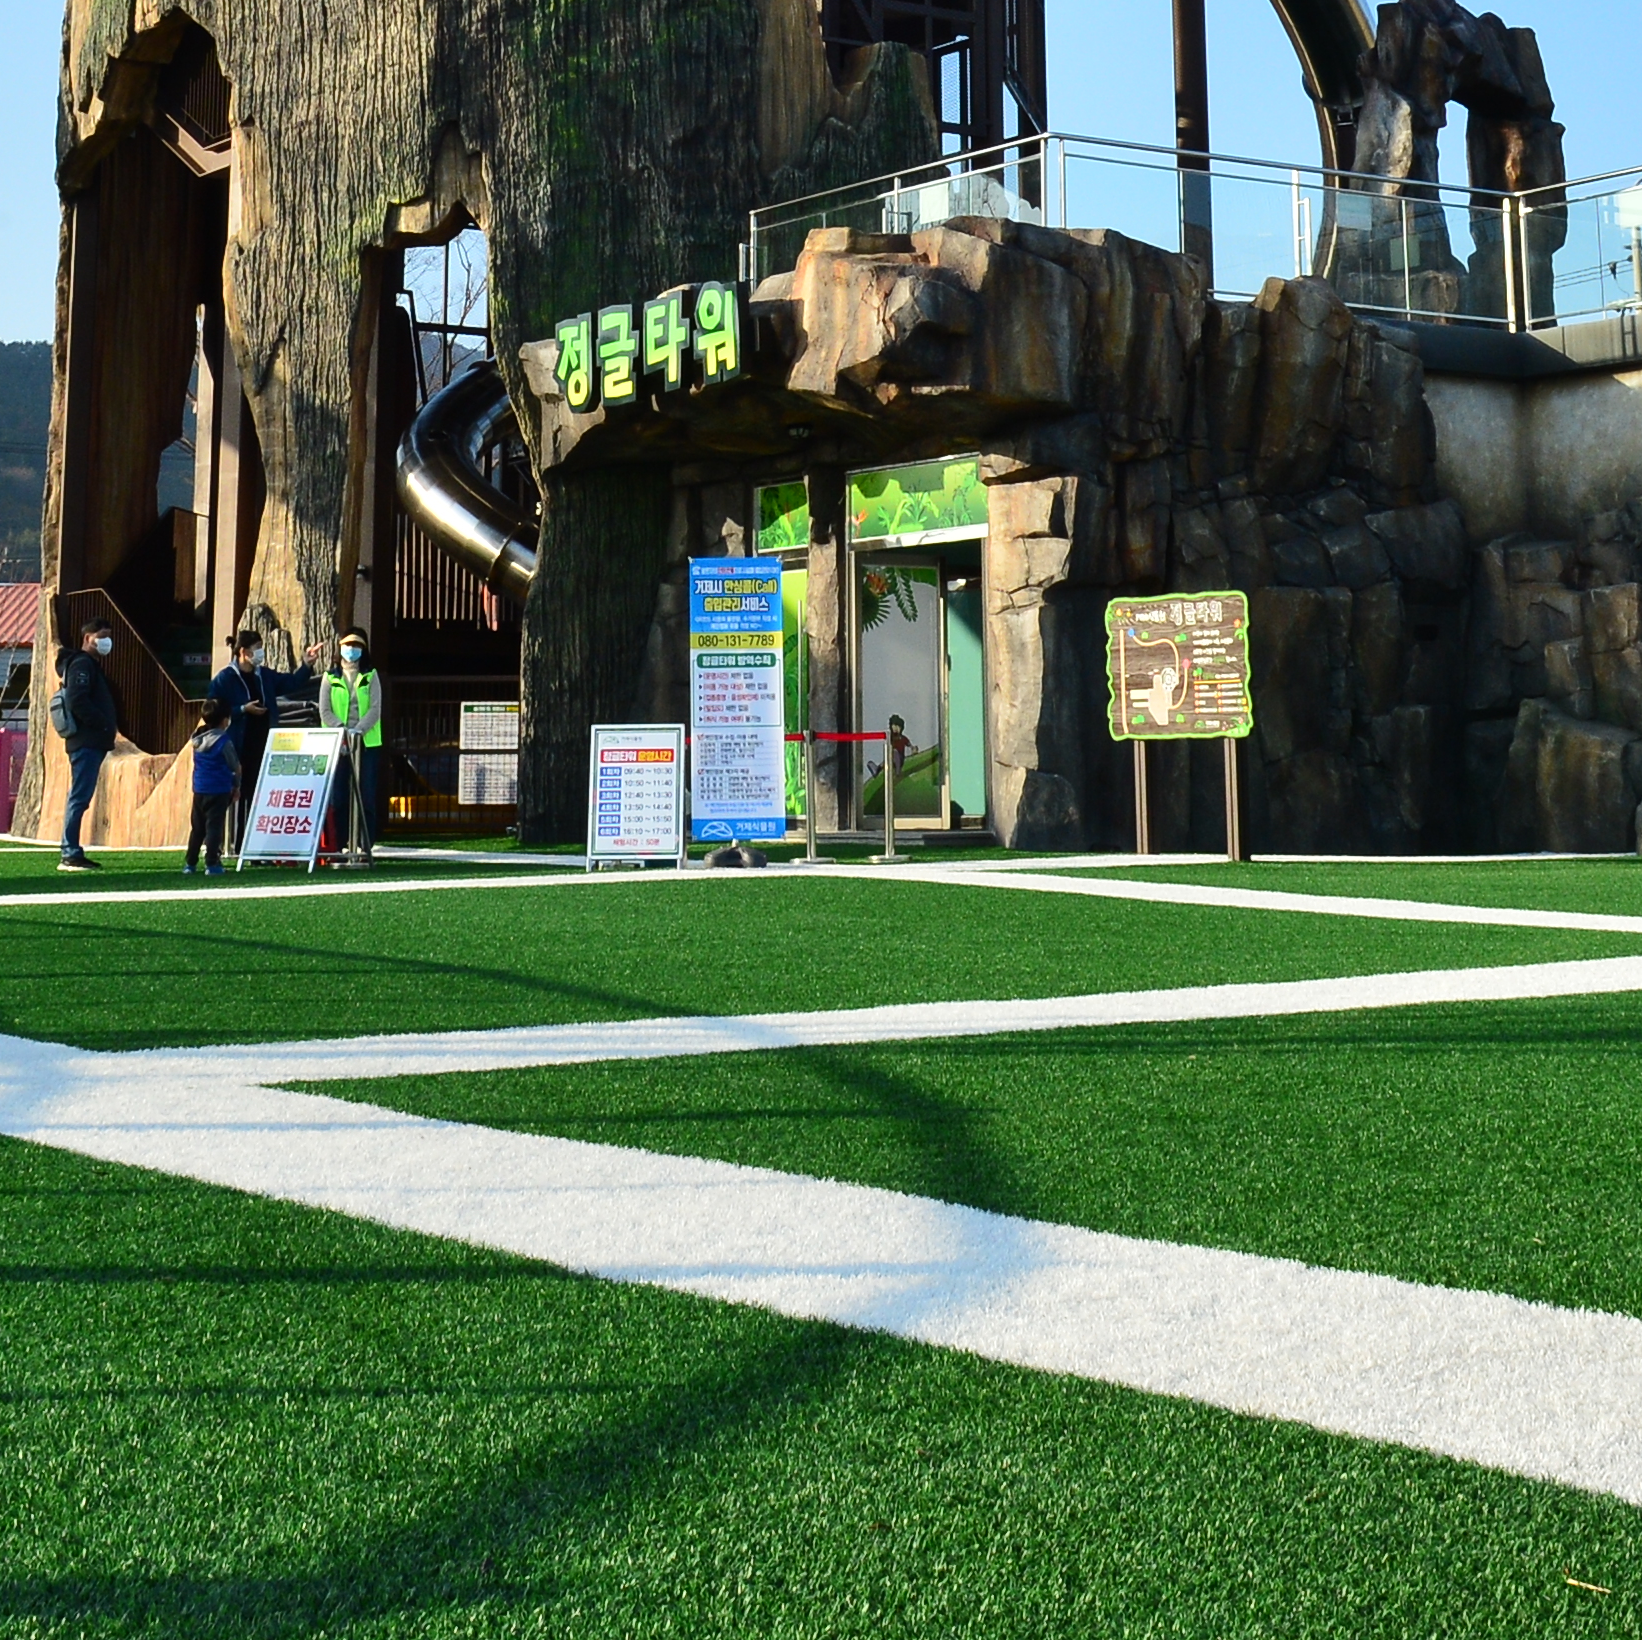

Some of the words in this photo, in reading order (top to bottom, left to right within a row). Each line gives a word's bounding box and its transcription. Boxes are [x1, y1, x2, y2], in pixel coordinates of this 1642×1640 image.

[557, 288, 736, 407] 정글타워
[695, 579, 723, 594] 거제시
[1170, 600, 1223, 626] 정글타워
[698, 634, 775, 647] 080-131-7789
[268, 754, 329, 776] 정글타워
[267, 788, 314, 808] 체험권
[256, 815, 312, 834] 확인장소
